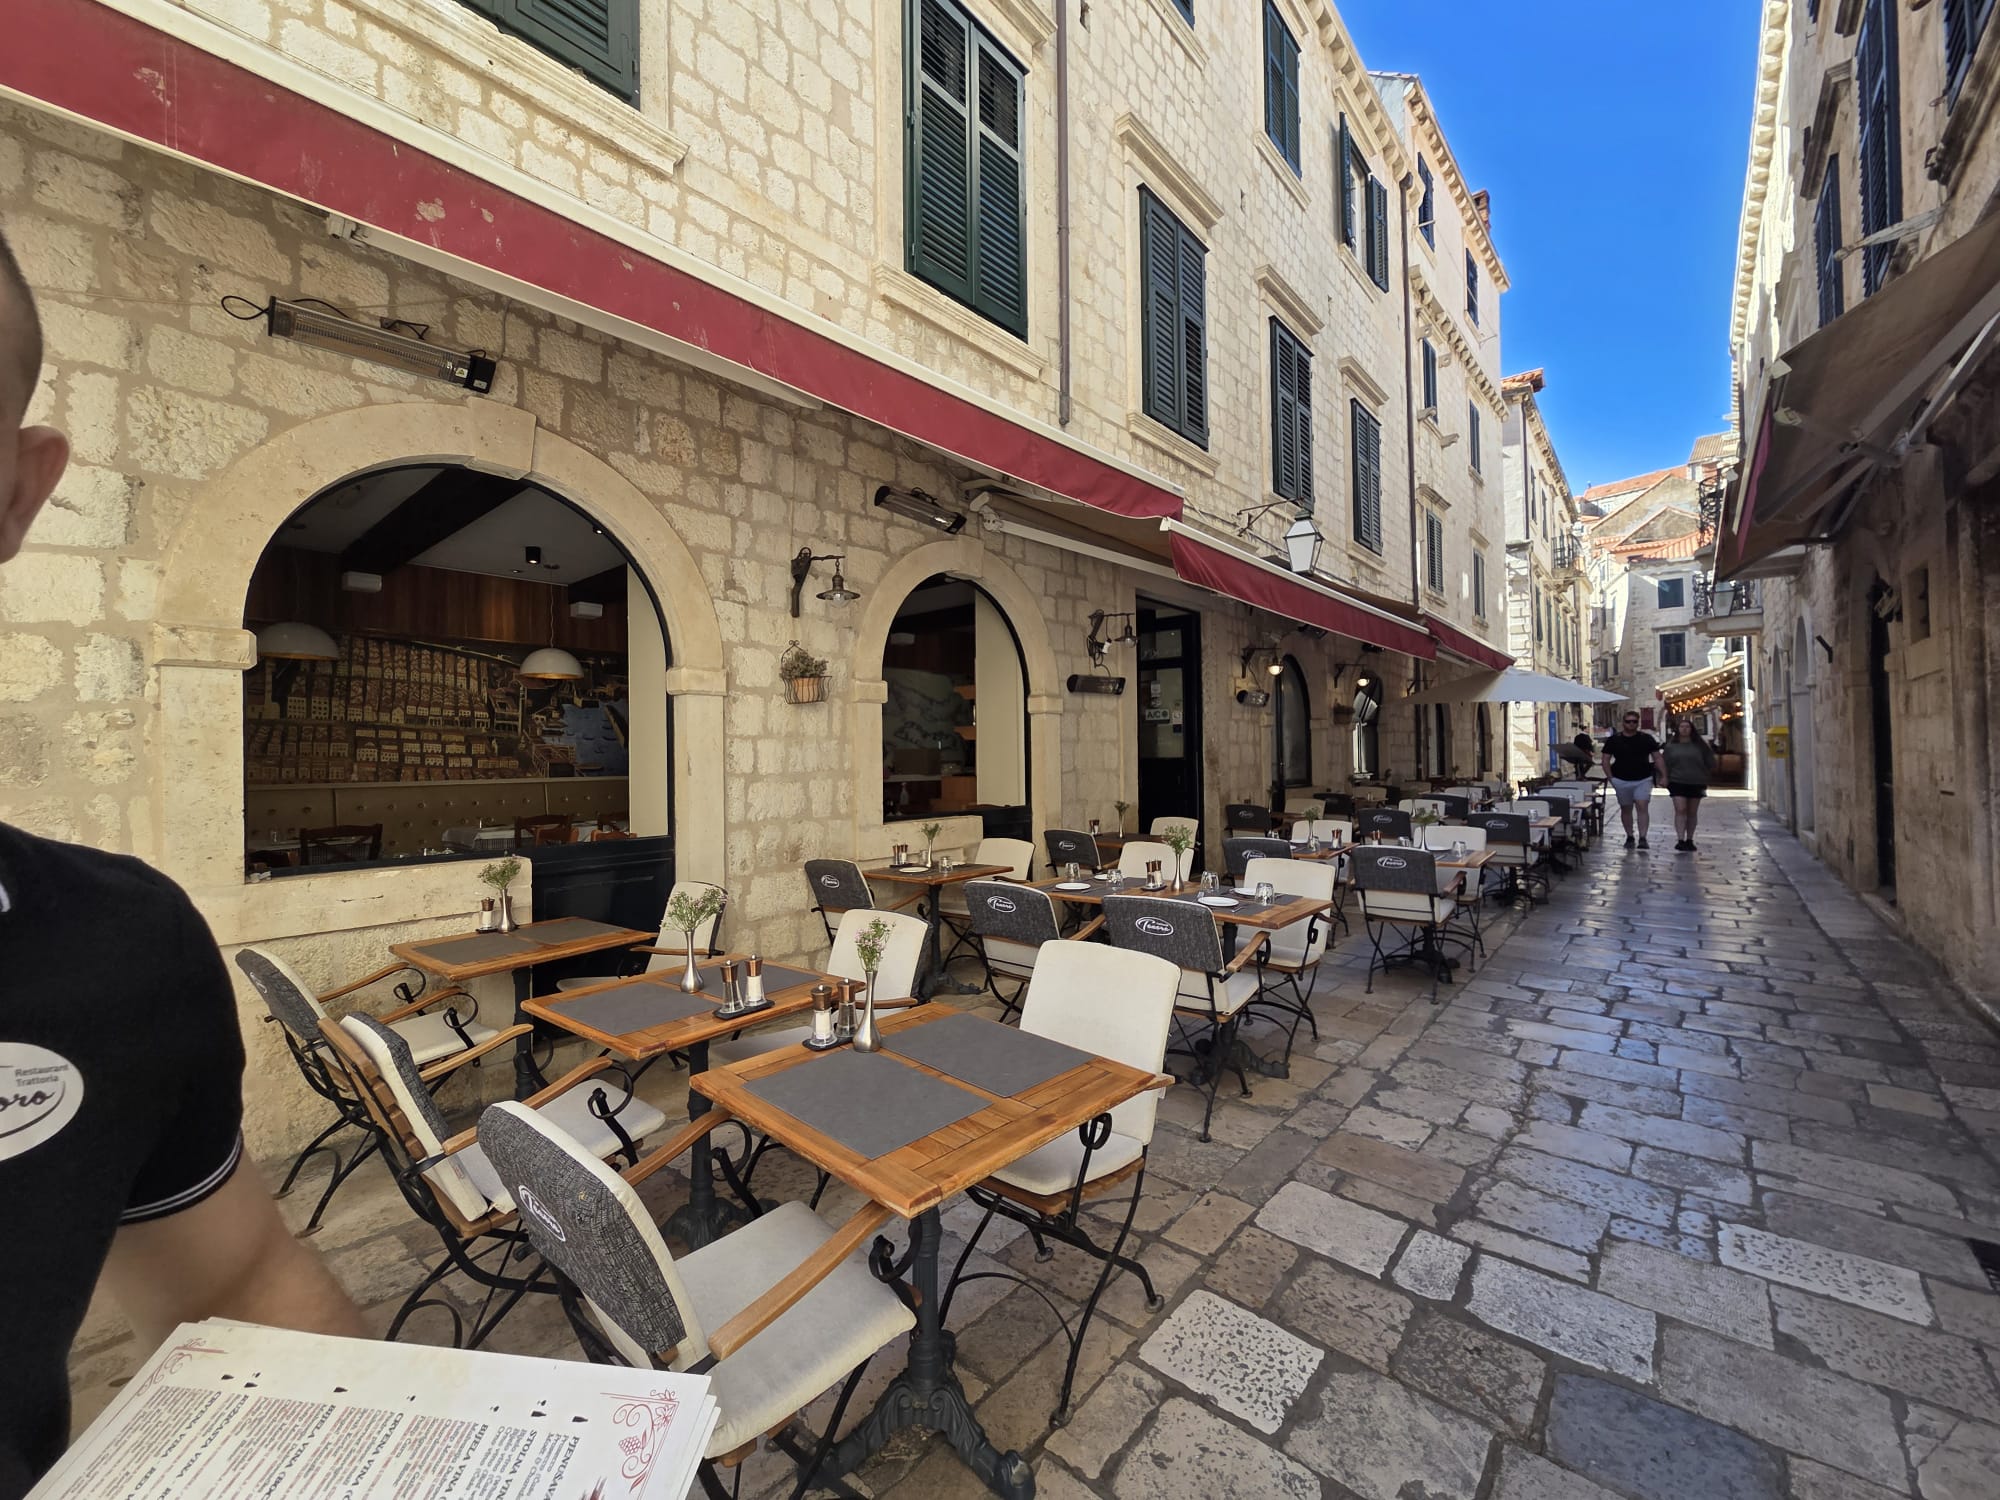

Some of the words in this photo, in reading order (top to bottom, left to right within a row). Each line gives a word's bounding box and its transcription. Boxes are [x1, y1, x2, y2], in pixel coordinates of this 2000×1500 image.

[15, 1064, 69, 1077] Restaurant
[16, 1075, 59, 1087] Trattoria
[185, 1391, 222, 1430] CRVENA
[307, 1404, 336, 1439] BIJELA
[160, 1433, 186, 1458] VINA
[372, 1412, 404, 1455] CRVENA
[463, 1424, 489, 1461] BIJELA
[175, 1452, 202, 1478] VINA
[284, 1442, 309, 1468] VINA
[509, 1430, 537, 1475] STOLNA
[261, 1471, 286, 1500] (BOC
[351, 1459, 375, 1486] VINA
[444, 1464, 466, 1493] VINA
[494, 1478, 513, 1500] VIN
